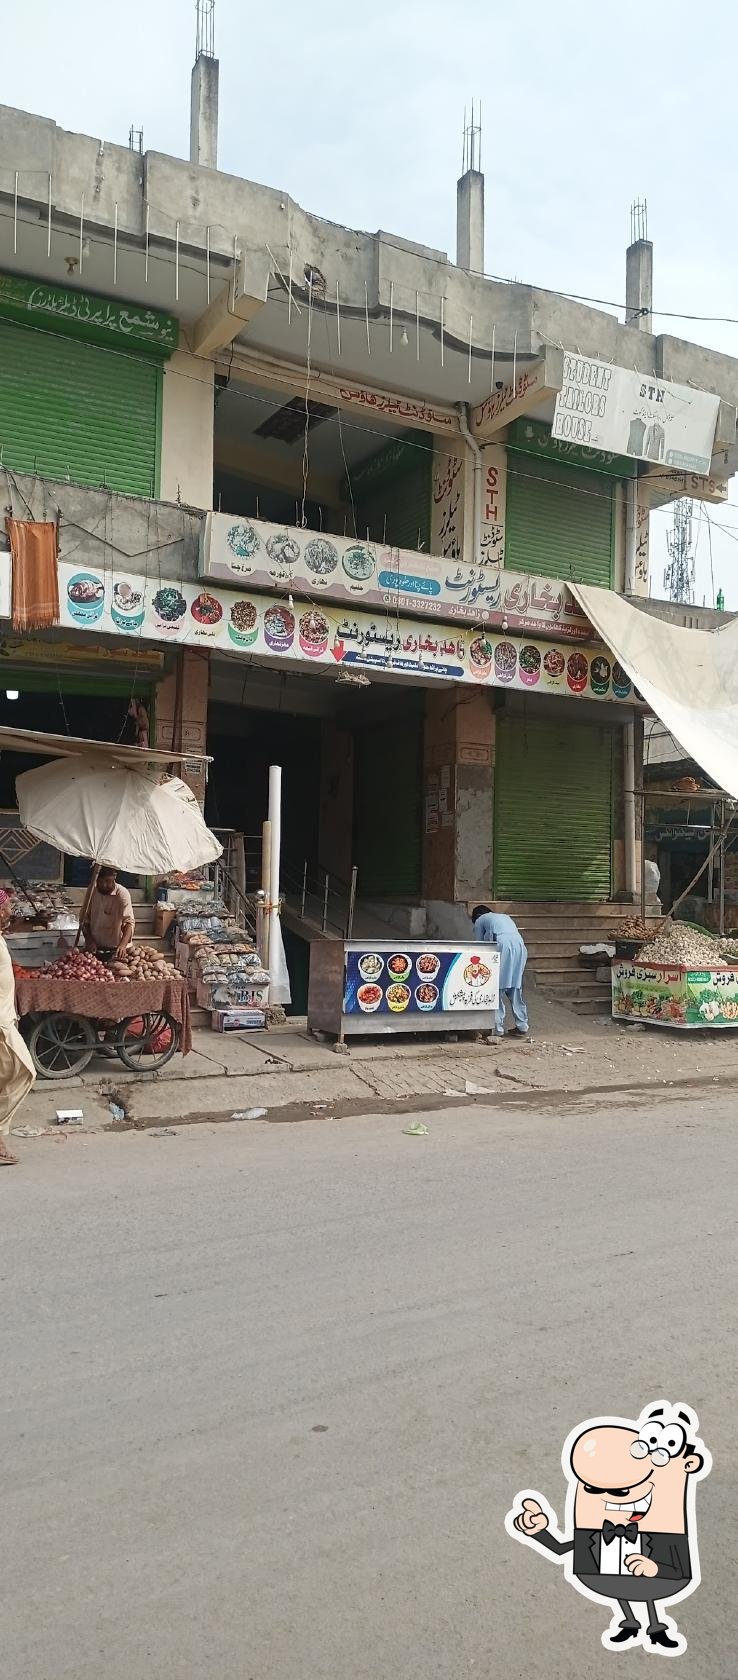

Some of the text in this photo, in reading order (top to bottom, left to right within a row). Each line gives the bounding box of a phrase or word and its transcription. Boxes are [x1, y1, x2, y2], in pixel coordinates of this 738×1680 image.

[563, 355, 612, 391] STUDENT
[554, 412, 592, 442] HOUSE
[485, 466, 499, 521] STH
[444, 567, 502, 608] ریسٹورنٹ
[504, 577, 564, 621] بخاری
[402, 633, 439, 657] بخاری
[439, 637, 466, 661] زاہد
[616, 963, 636, 979] فروش
[636, 968, 657, 982] سبزی
[656, 970, 682, 984] اسرار
[712, 973, 735, 986] فروش
